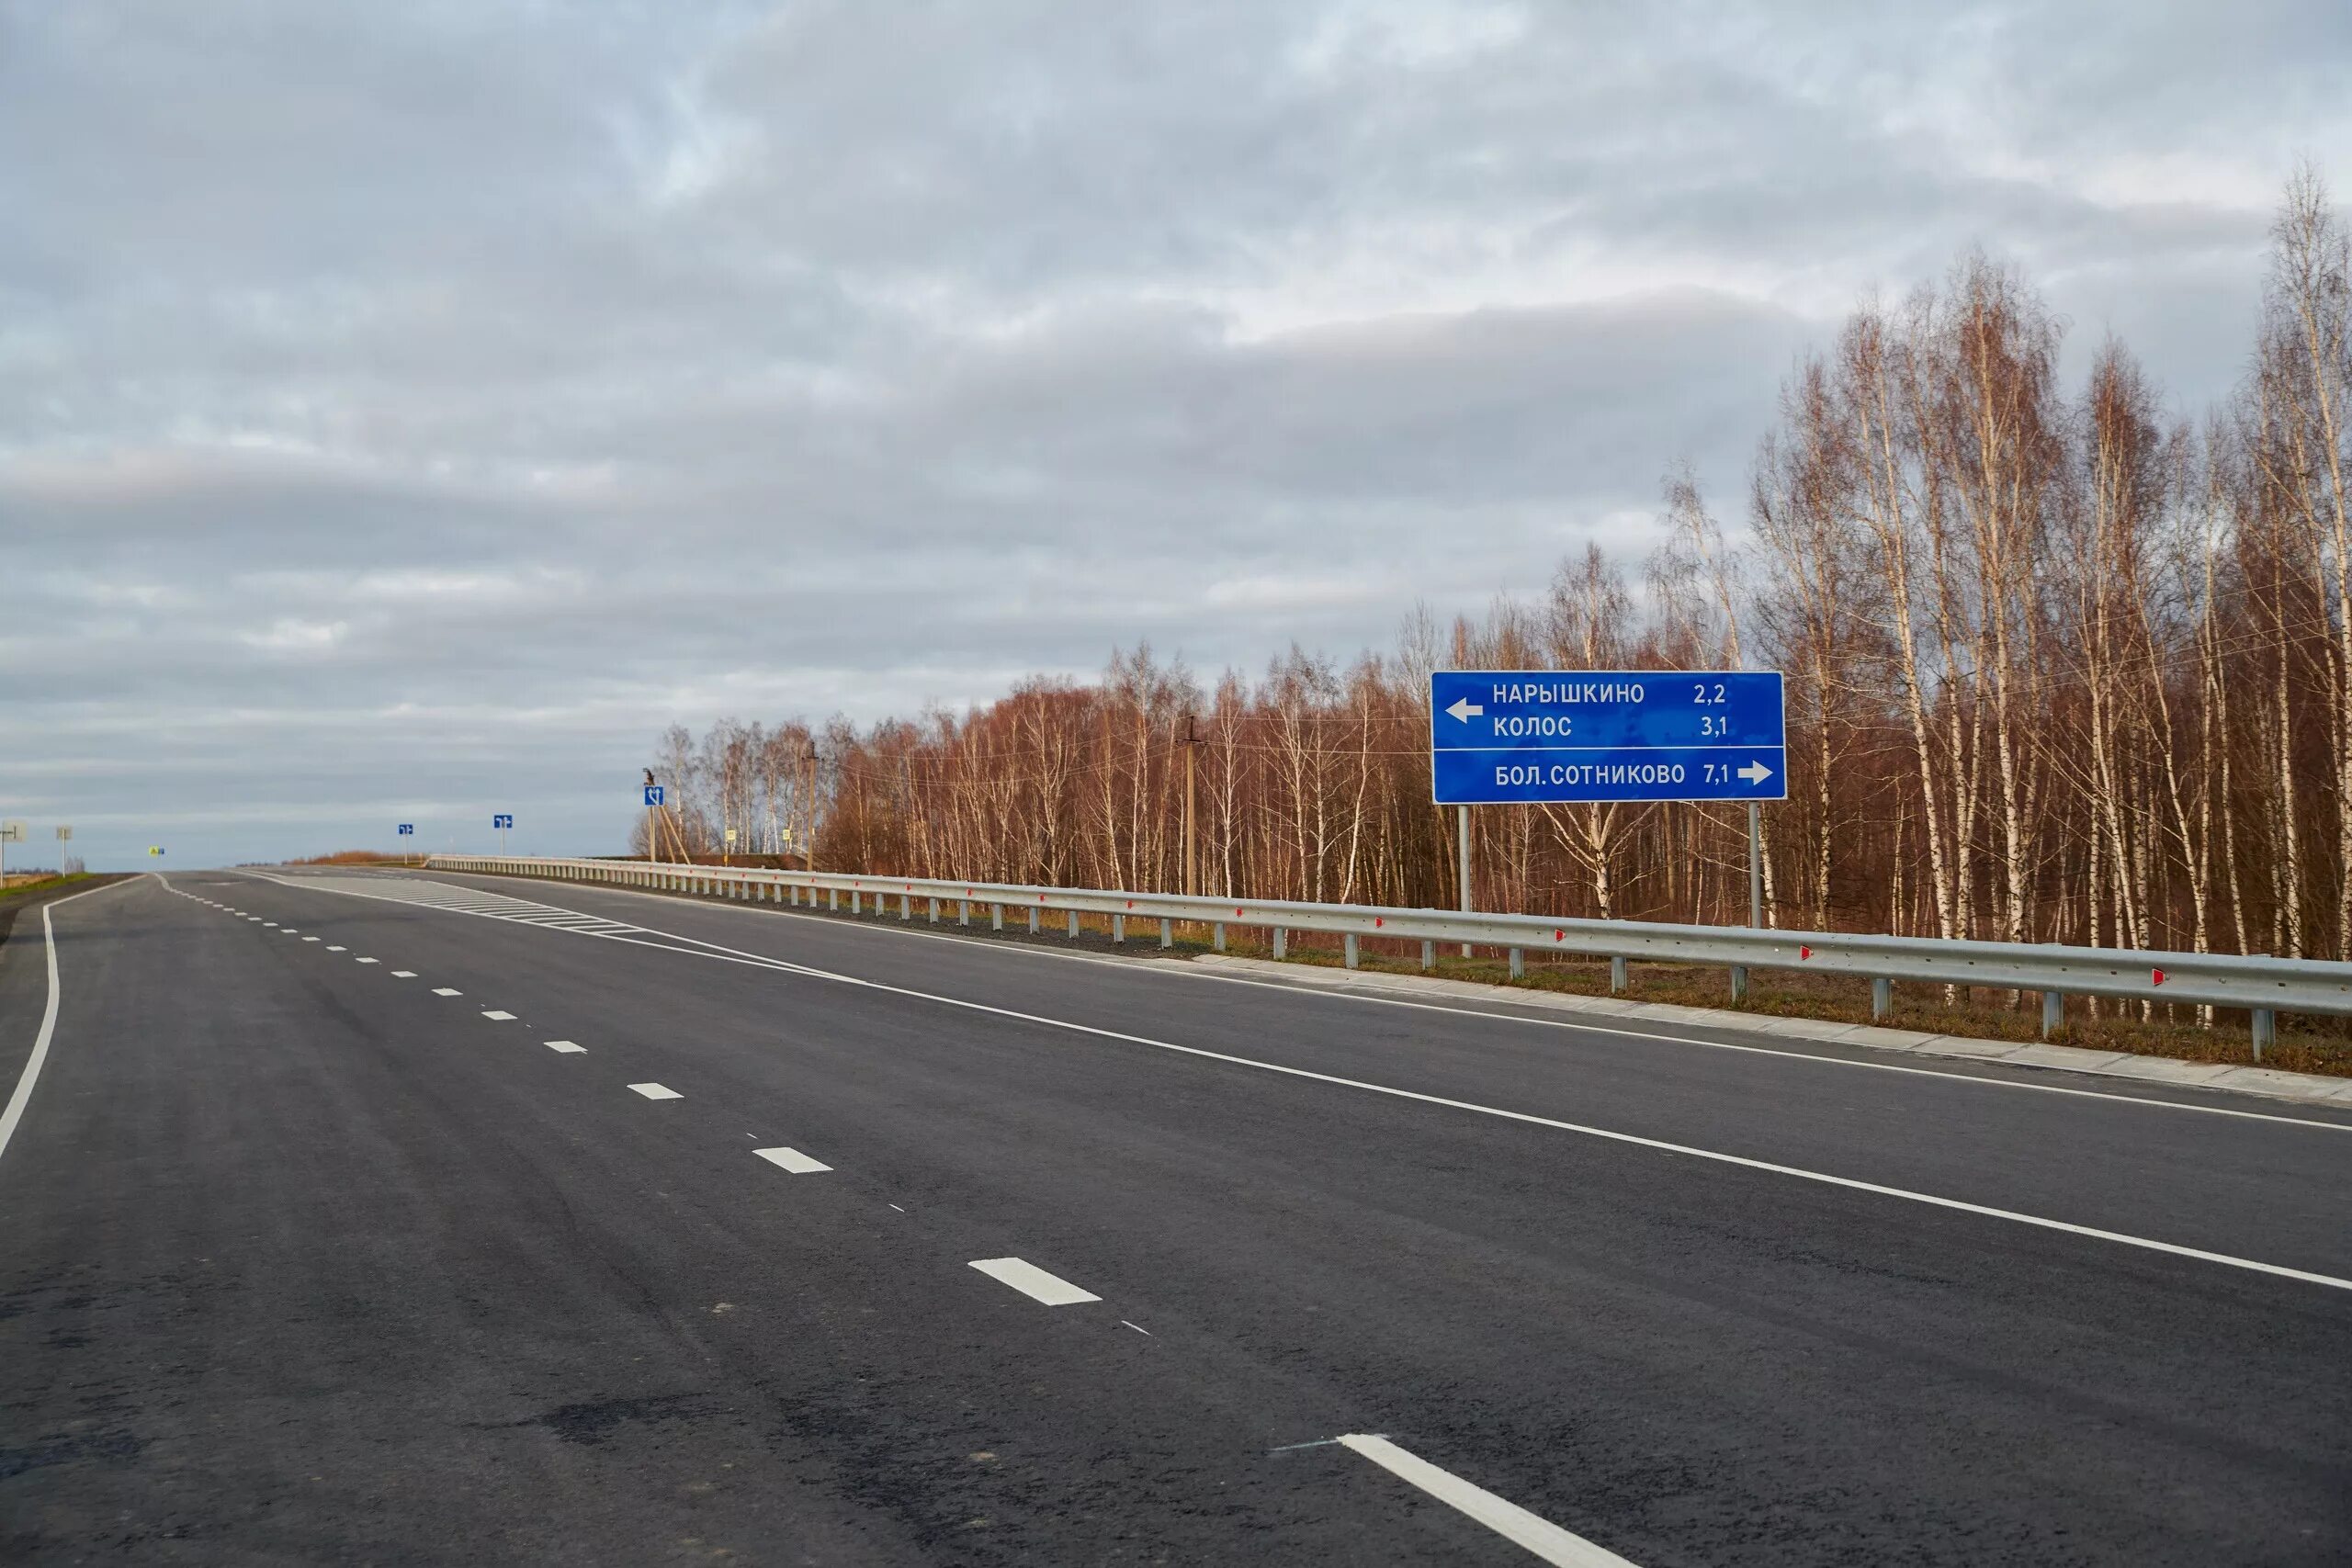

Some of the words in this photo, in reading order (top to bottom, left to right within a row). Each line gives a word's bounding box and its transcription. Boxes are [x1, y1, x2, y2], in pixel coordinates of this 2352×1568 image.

[1492, 683, 1645, 705] НАРЫШКИНО
[1692, 683, 1726, 706] 2,2
[1493, 716, 1573, 738] КОЛОС
[1700, 716, 1728, 738] 3,1
[1495, 764, 1686, 786] БОЛ.СОТНИКОВО
[1702, 763, 1730, 785] 7,1
